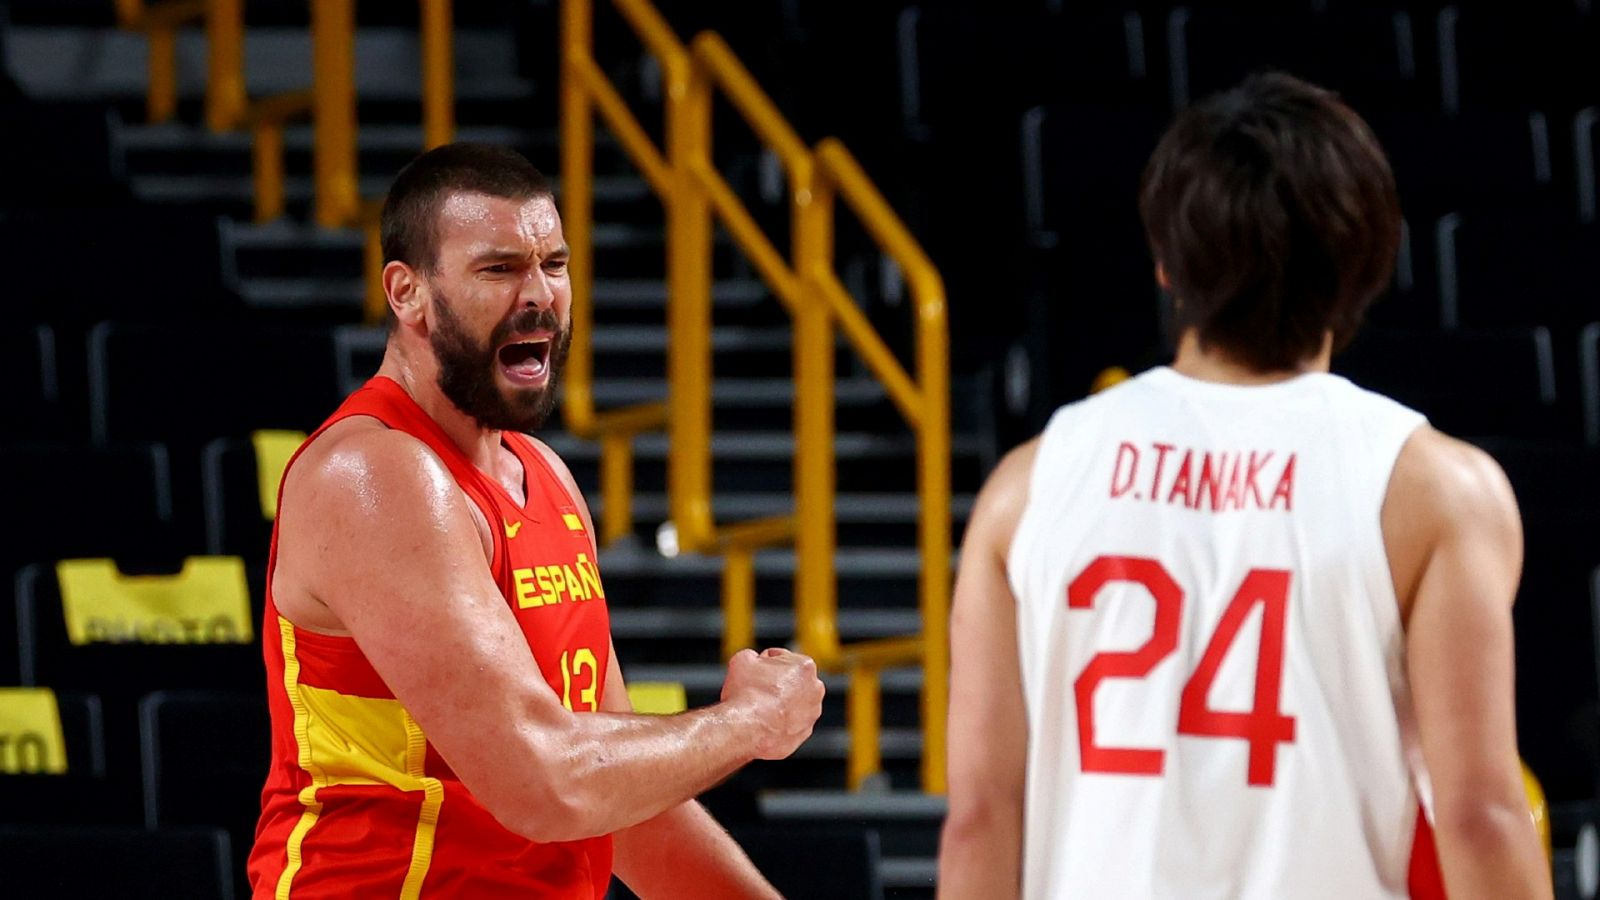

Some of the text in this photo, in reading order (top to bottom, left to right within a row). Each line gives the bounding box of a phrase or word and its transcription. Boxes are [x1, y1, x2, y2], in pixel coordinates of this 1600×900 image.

[1109, 441, 1297, 512] D.TANAKA
[561, 648, 597, 712] 13
[1067, 554, 1297, 789] 24
